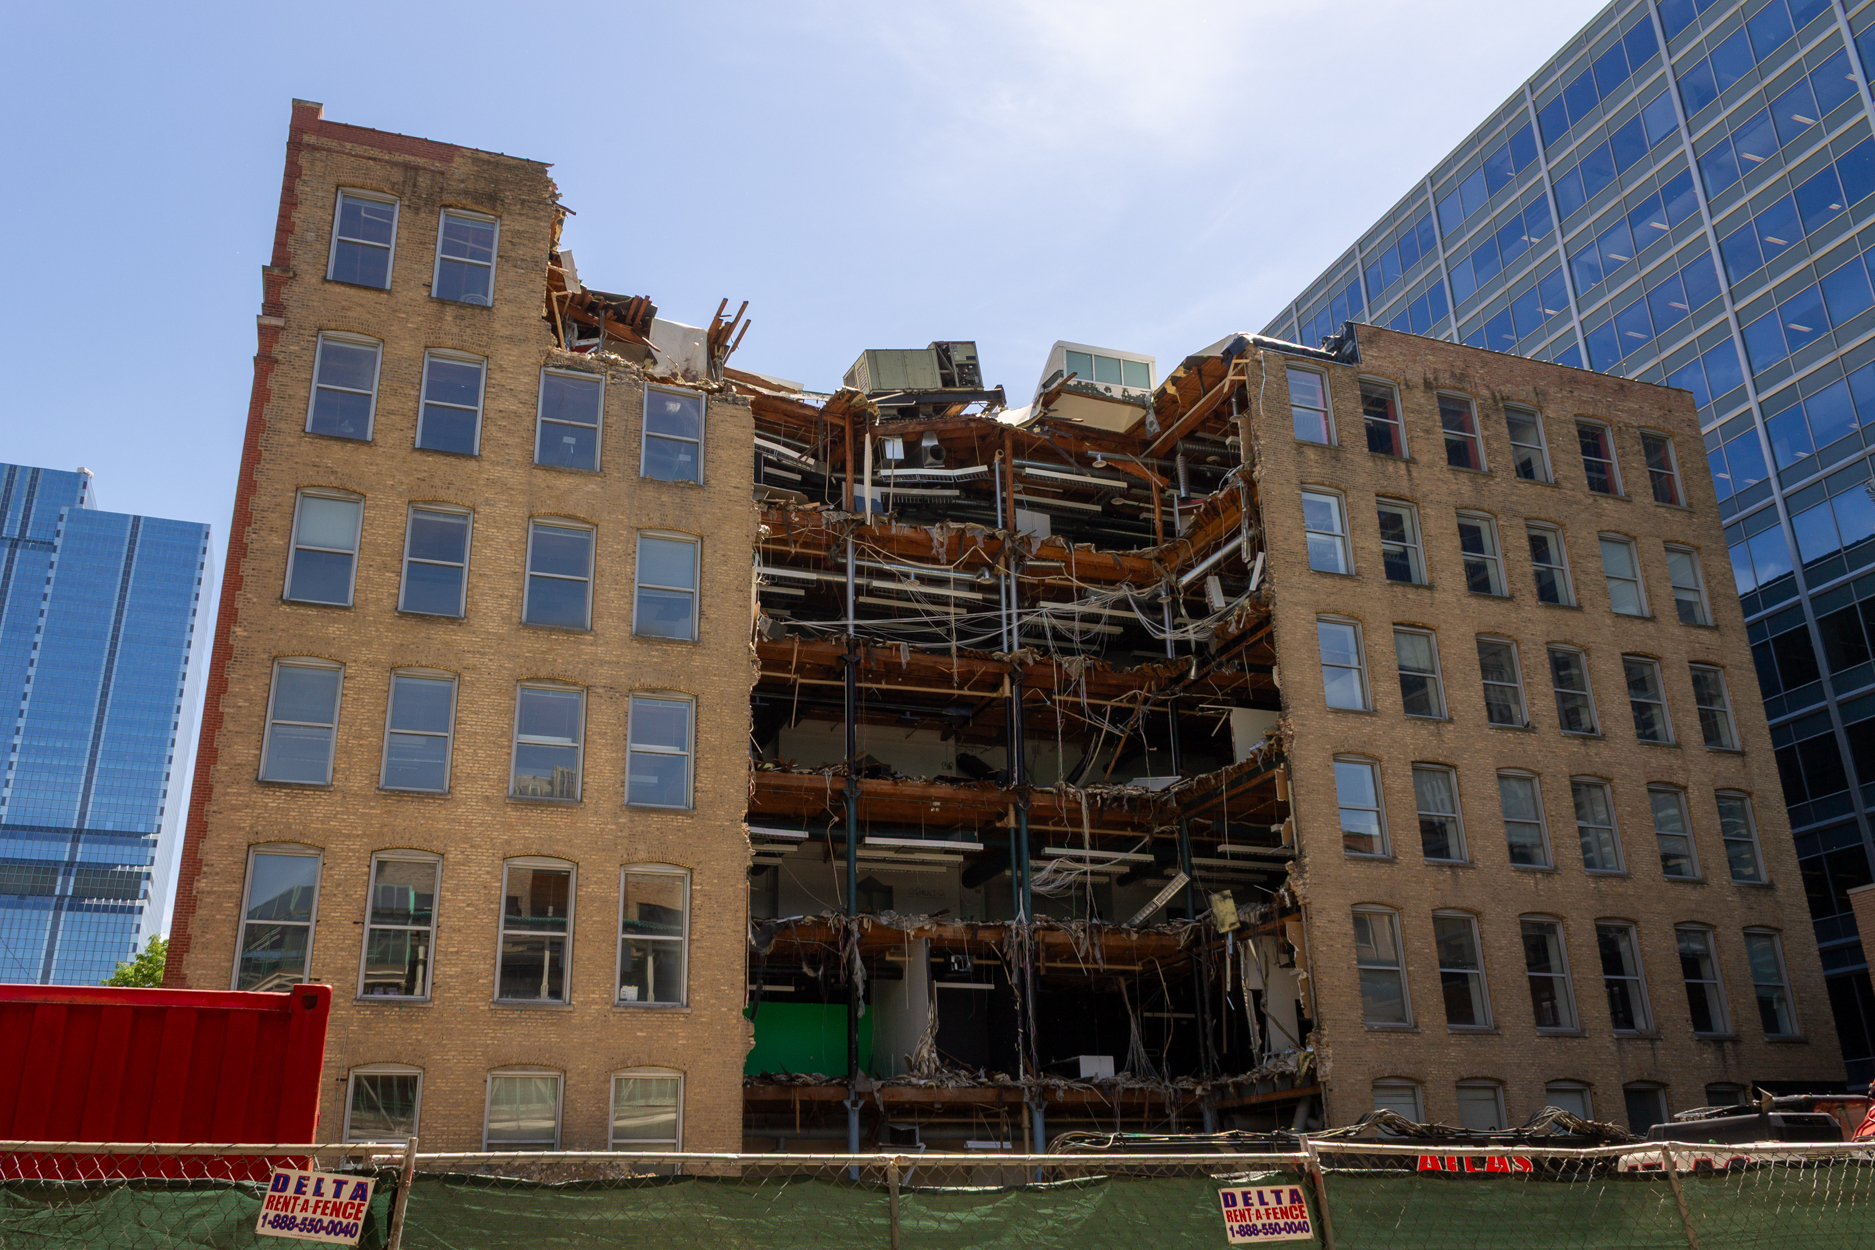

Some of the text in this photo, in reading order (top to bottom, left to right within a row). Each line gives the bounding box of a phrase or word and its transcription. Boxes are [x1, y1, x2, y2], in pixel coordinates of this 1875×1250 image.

[270, 1172, 369, 1202] DELTA
[1221, 1188, 1304, 1208] DELTA
[265, 1194, 365, 1221] RENT-A-FENCE
[1225, 1205, 1307, 1223] RENT-A-FENCE
[261, 1212, 359, 1238] 1-888-550-0040
[1229, 1220, 1310, 1238] 1-888-550-0040
